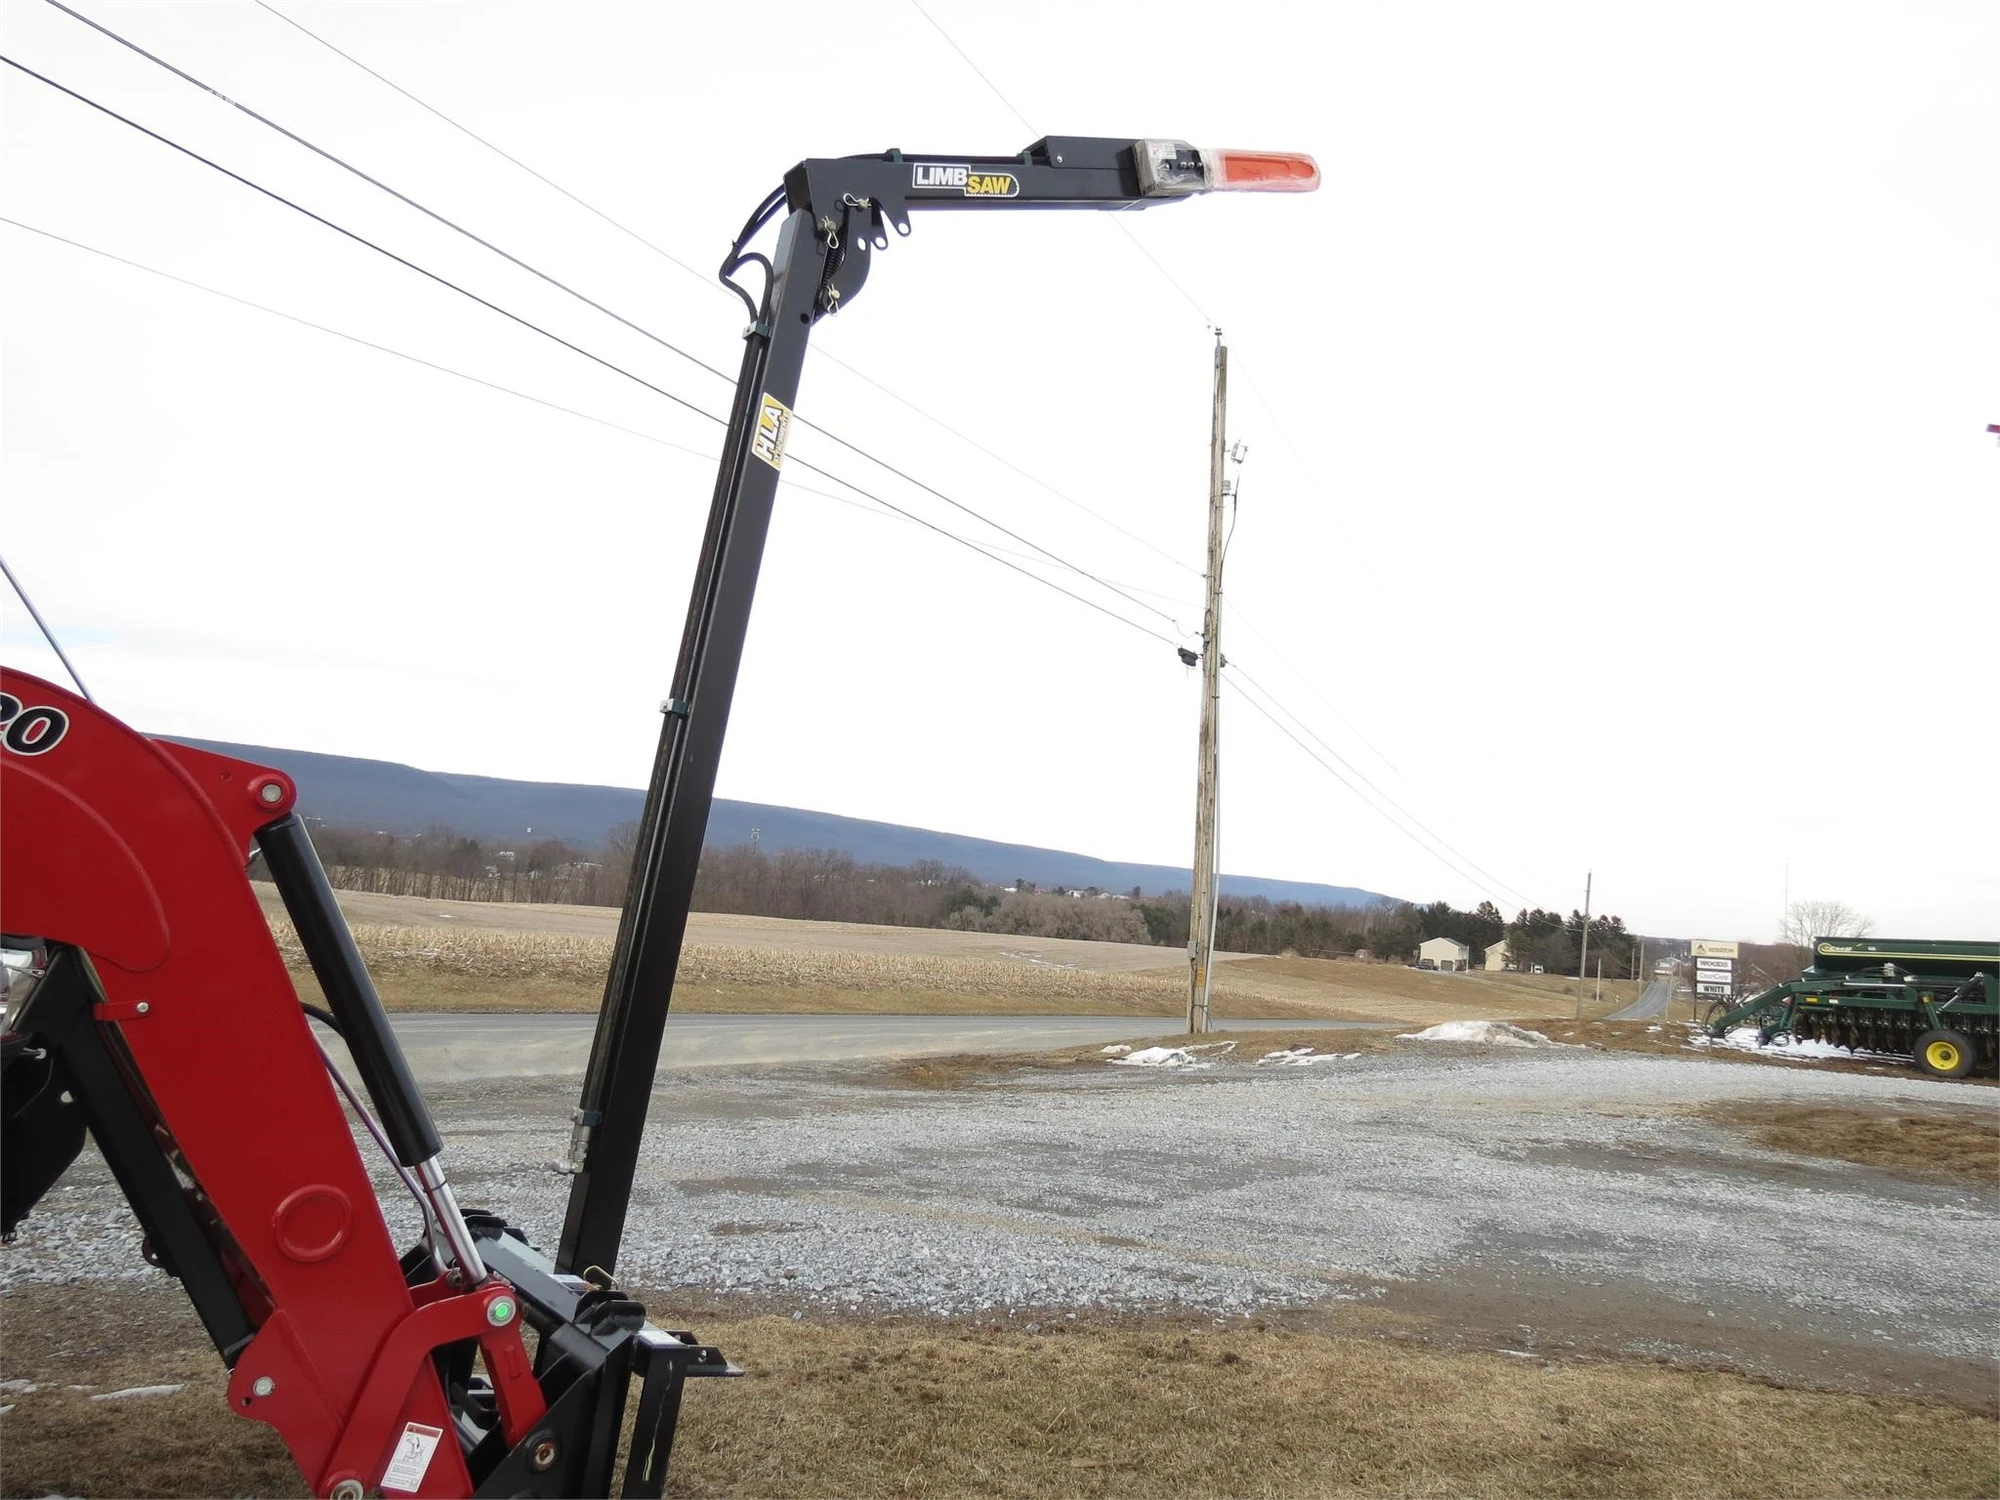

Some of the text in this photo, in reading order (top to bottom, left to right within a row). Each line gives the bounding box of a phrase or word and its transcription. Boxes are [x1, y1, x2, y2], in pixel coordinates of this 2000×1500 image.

[916, 167, 1011, 194] LIMB SAW
[756, 405, 784, 462] HLA
[1699, 960, 1729, 968] WOODS
[1703, 985, 1725, 994] WHITE
